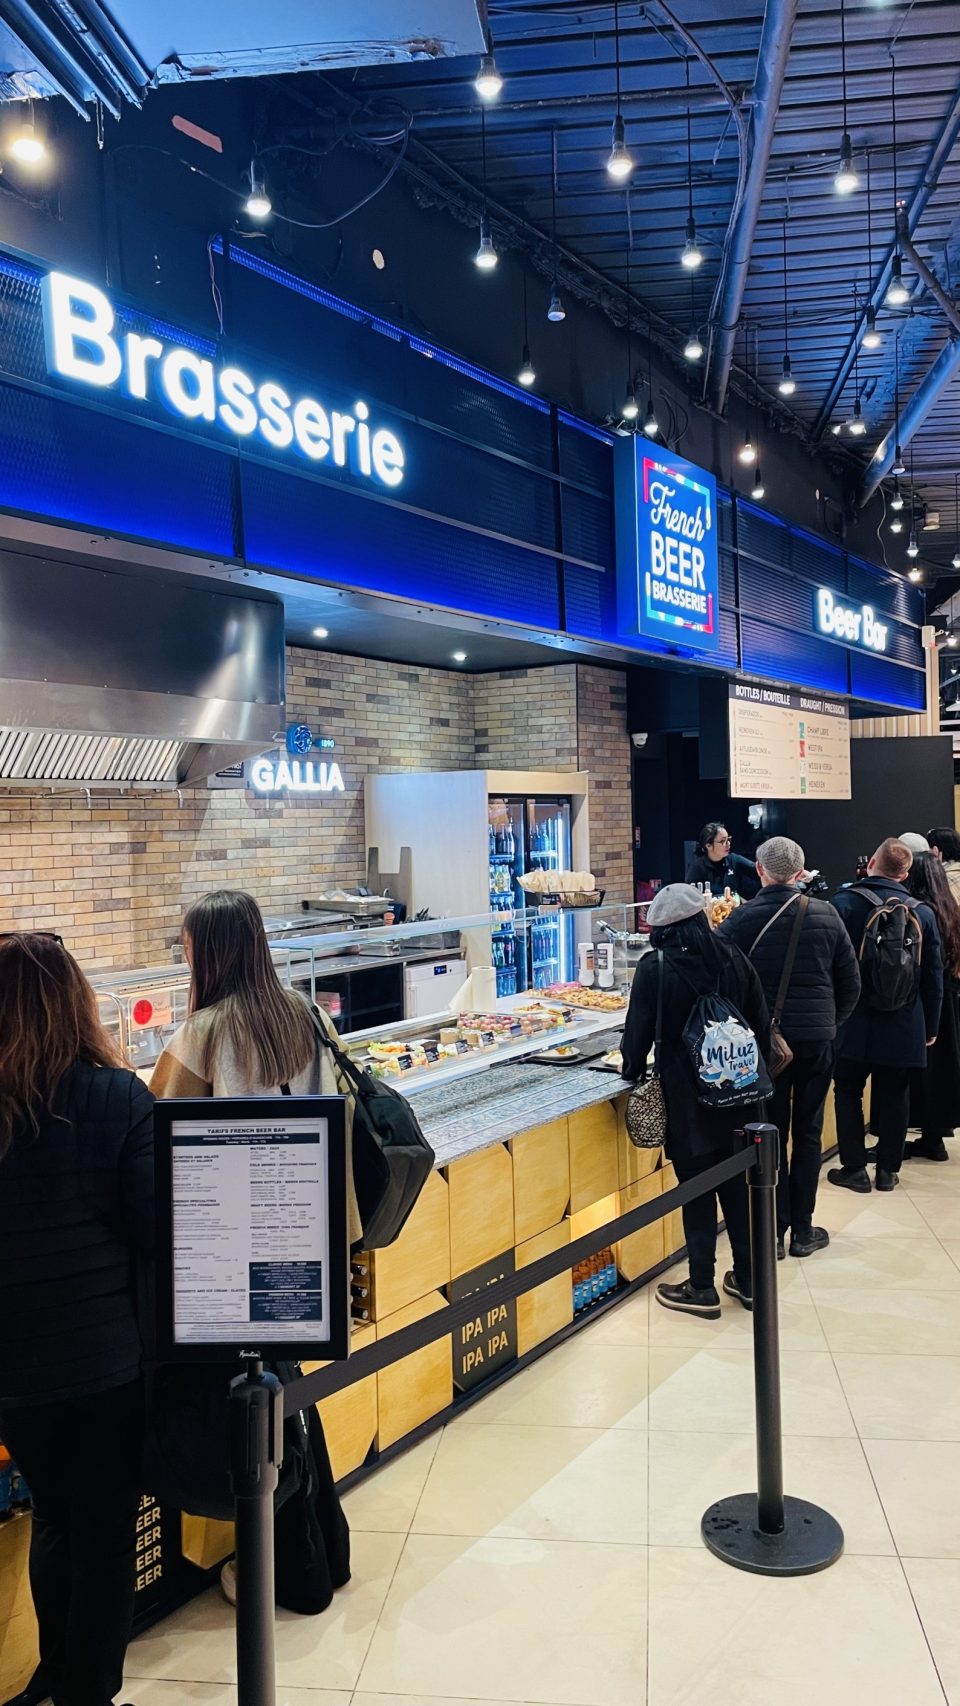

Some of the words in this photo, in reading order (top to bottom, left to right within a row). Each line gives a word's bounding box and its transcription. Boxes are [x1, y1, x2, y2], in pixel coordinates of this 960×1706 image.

[46, 270, 405, 486] Brasserie
[650, 481, 705, 541] French
[651, 530, 706, 591] BEER
[652, 579, 707, 614] BRASSERIE
[817, 588, 861, 641] Beer
[861, 604, 888, 652] Bar
[736, 685, 759, 700] BOTTLES
[763, 691, 790, 705] BOUTEILLE
[800, 698, 821, 711] DRAUGHT
[824, 703, 845, 715] PRESSION
[252, 758, 345, 791] GALLIA
[707, 1042, 754, 1068] MiLuz
[728, 1054, 755, 1071] Travel
[461, 1317, 483, 1345] IPA
[486, 1304, 508, 1328] IPA
[462, 1346, 484, 1374] IPA
[488, 1330, 509, 1358] IPA
[135, 1506, 161, 1533] EER
[135, 1525, 162, 1552] EER
[135, 1545, 162, 1572] EER
[134, 1564, 163, 1592] EER
